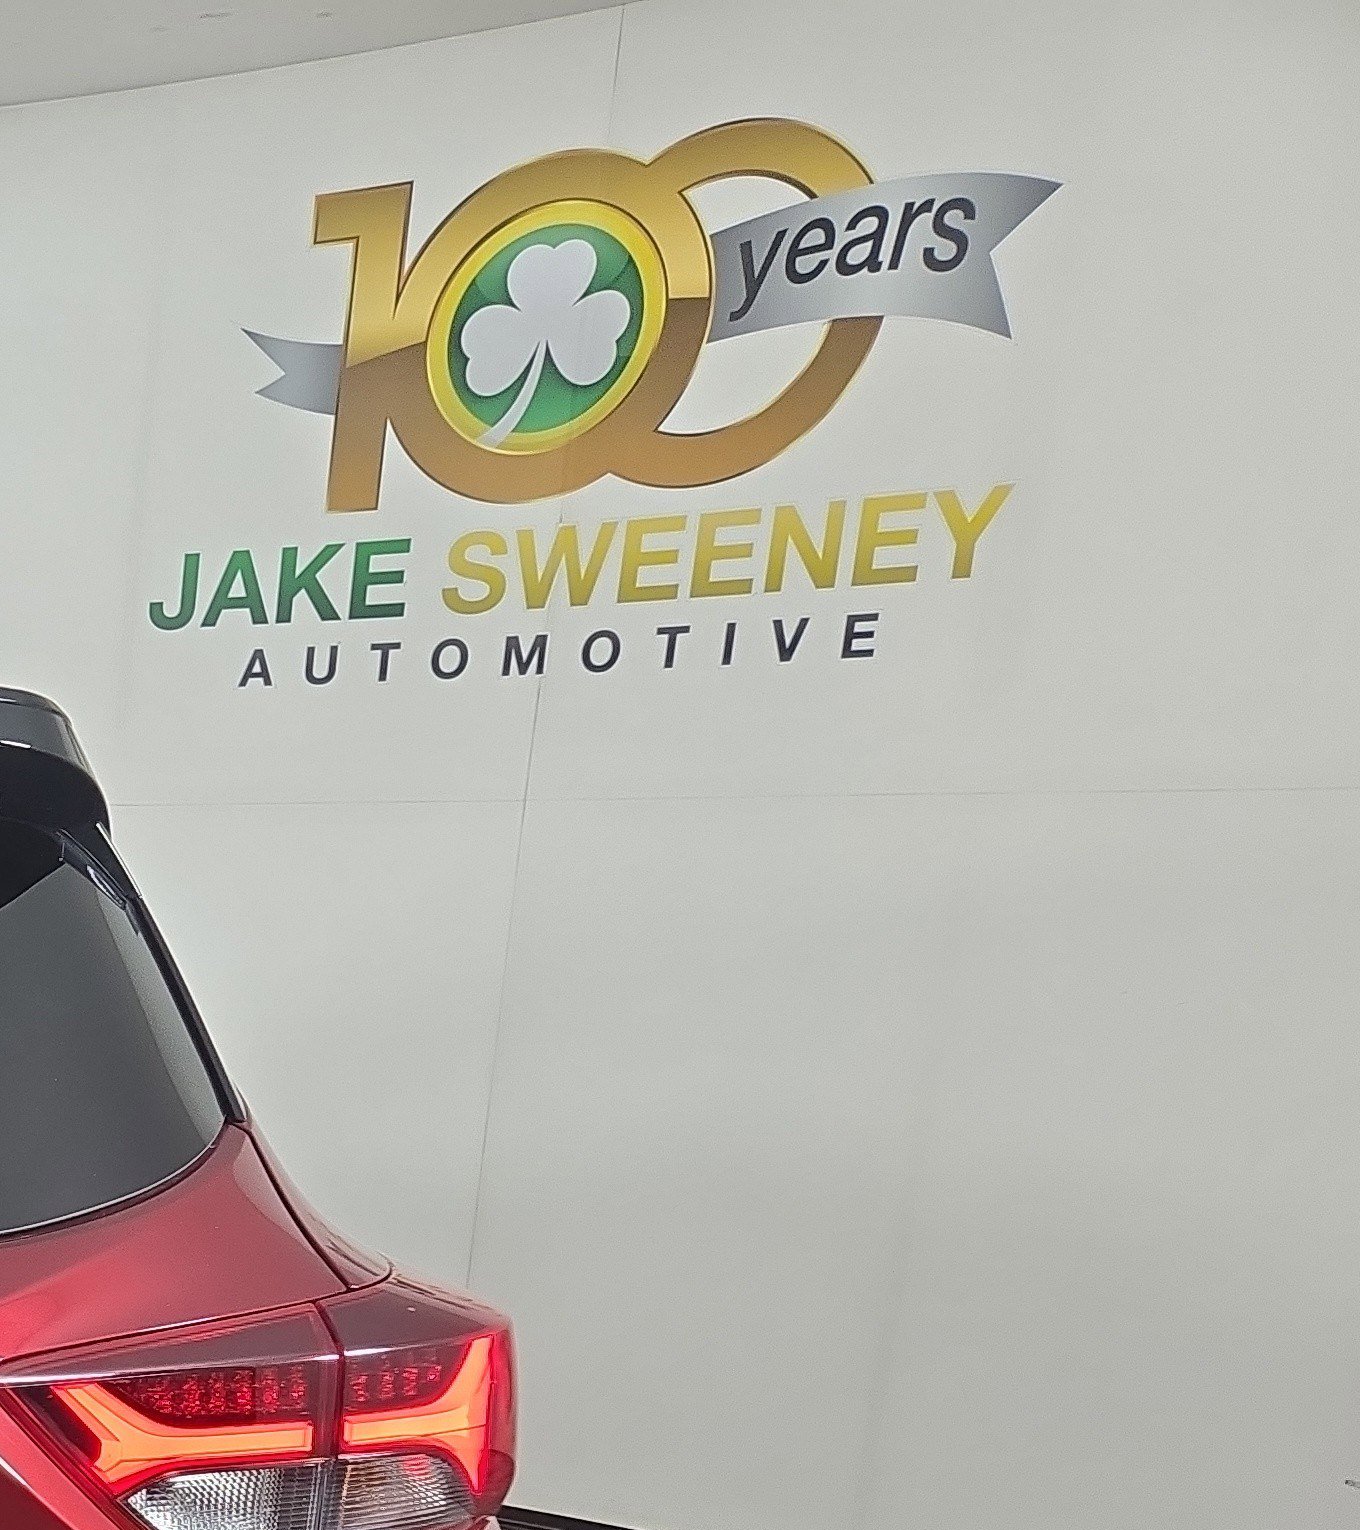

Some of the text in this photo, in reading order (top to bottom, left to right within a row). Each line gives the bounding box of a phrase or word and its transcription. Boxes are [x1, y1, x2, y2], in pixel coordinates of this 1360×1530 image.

[313, 116, 976, 513] 100 years
[147, 482, 1016, 631] JAKE SWEENEY
[237, 611, 880, 688] AUTOMOTIVE
